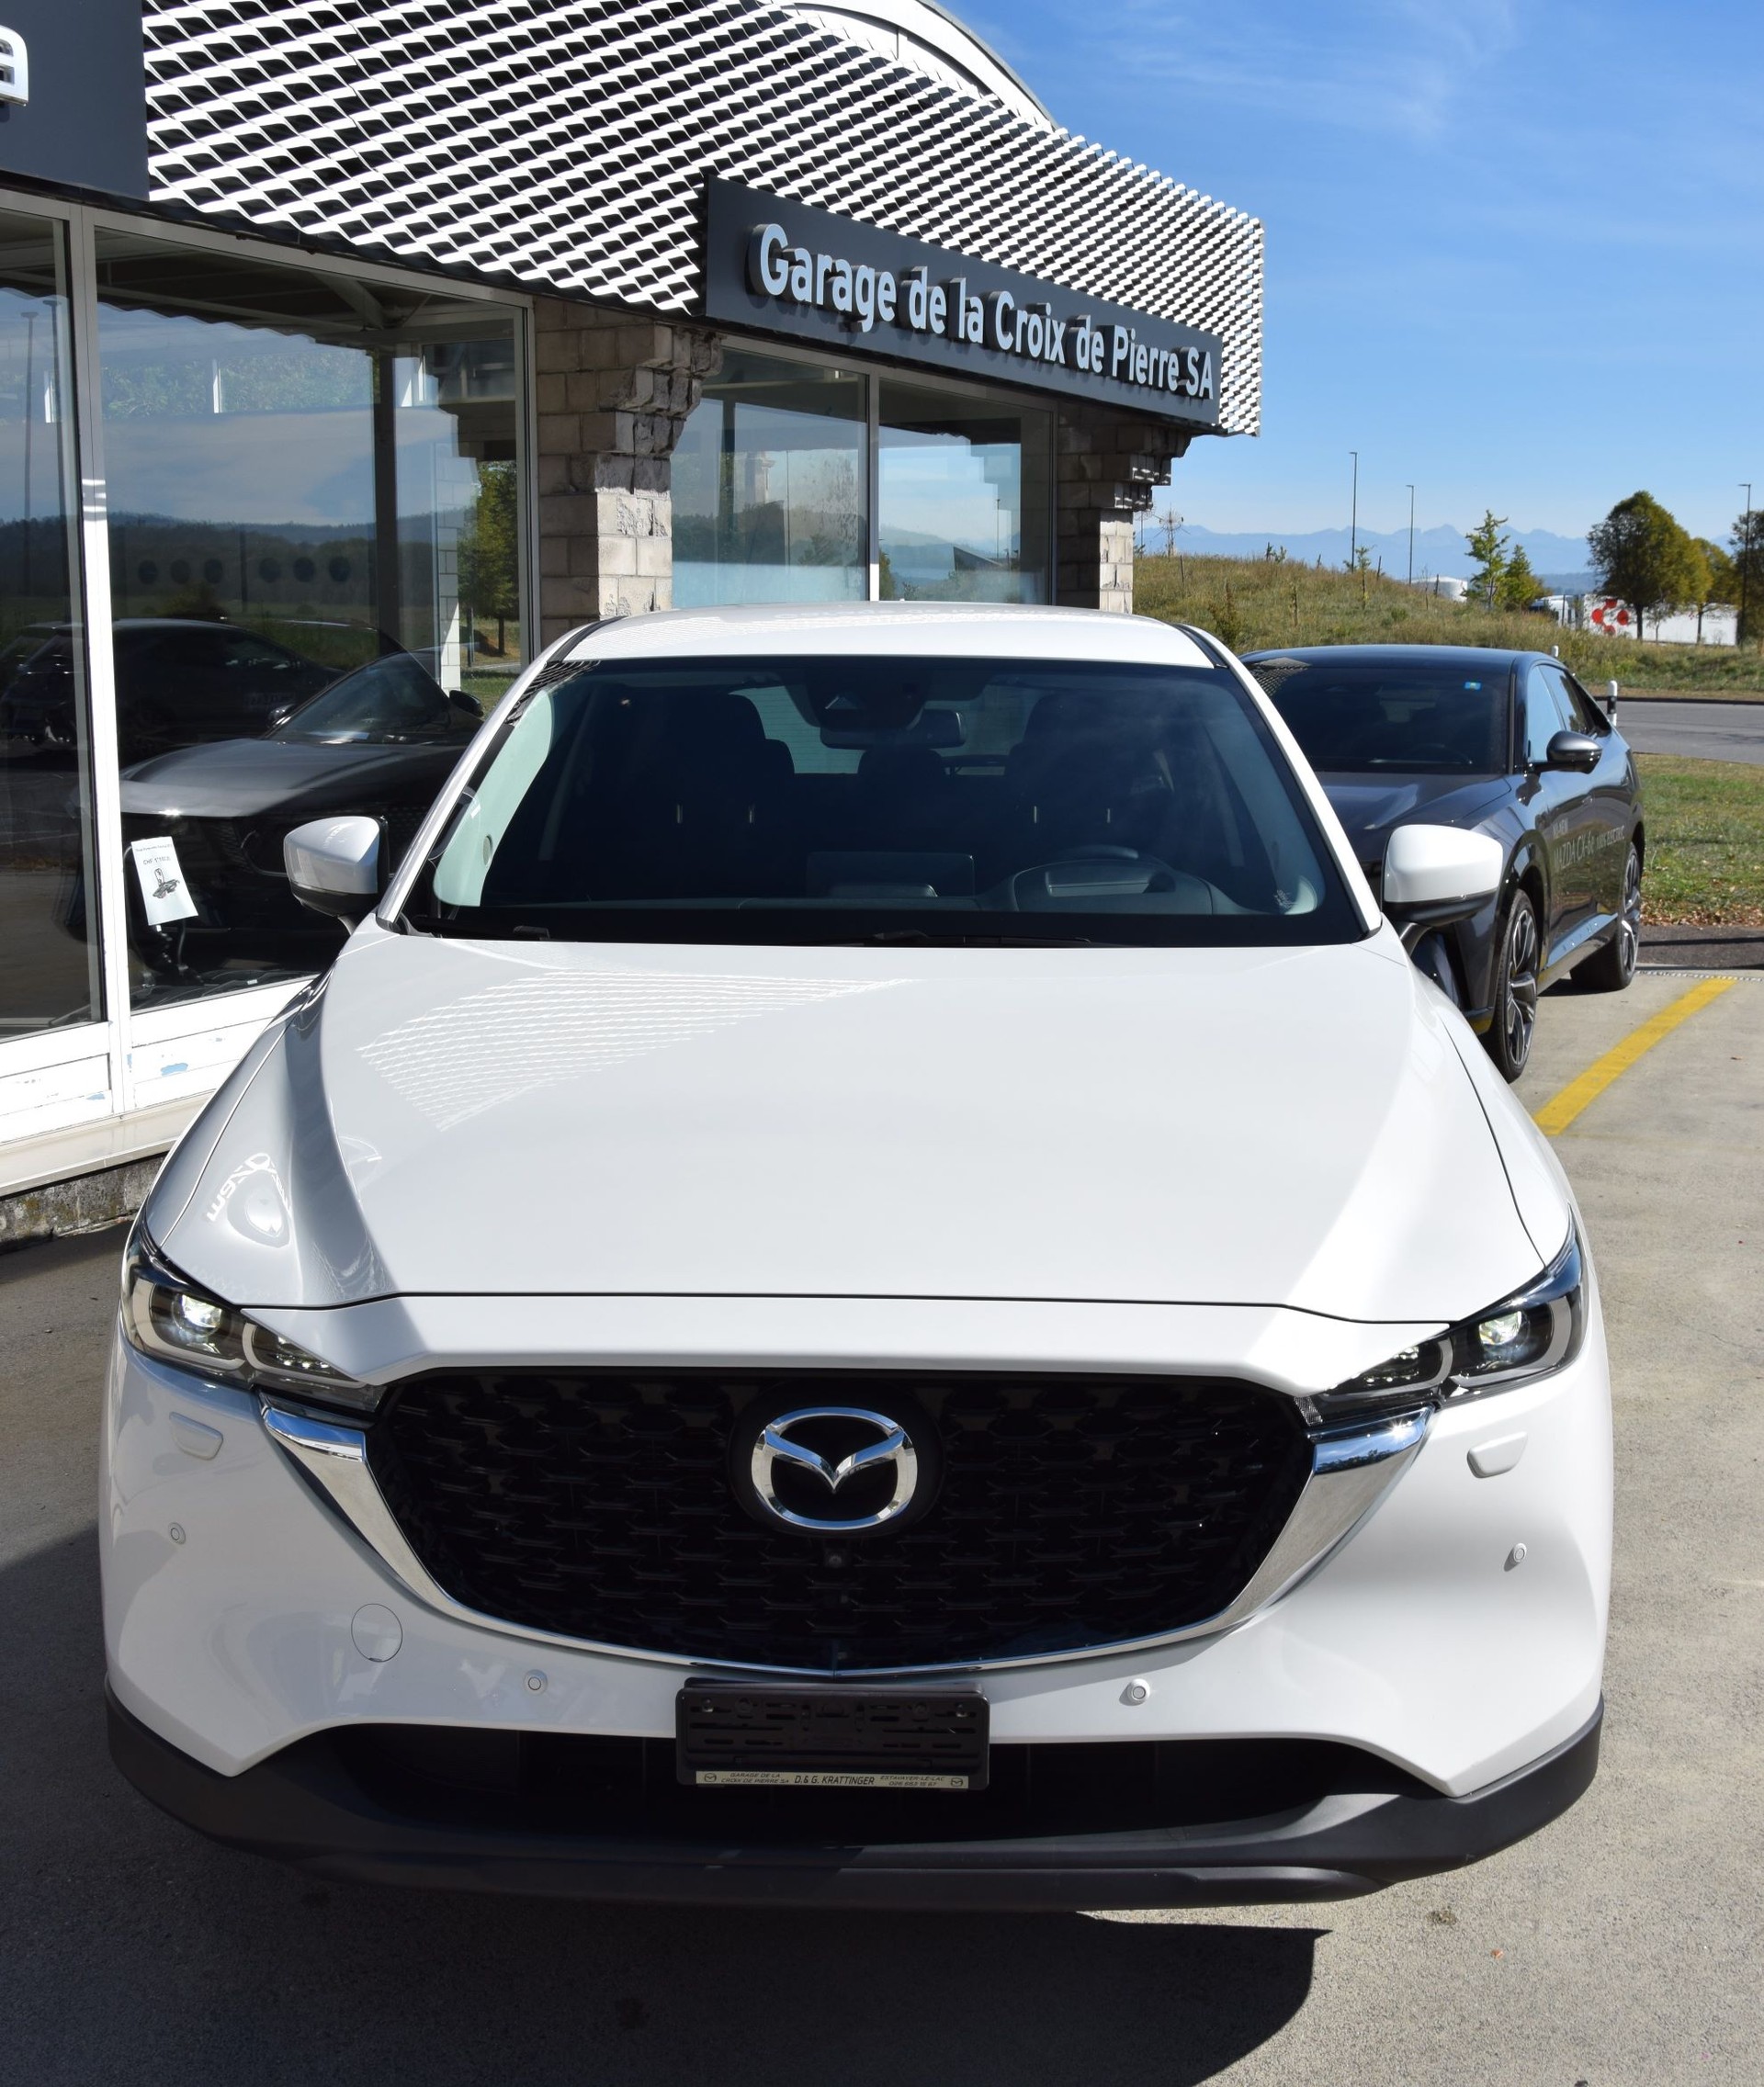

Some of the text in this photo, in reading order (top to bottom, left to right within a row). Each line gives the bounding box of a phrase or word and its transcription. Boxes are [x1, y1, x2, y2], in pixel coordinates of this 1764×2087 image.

[757, 223, 1215, 400] Garage de la Croix de Pierre SA
[821, 1775, 876, 1786] KRATTINGER
